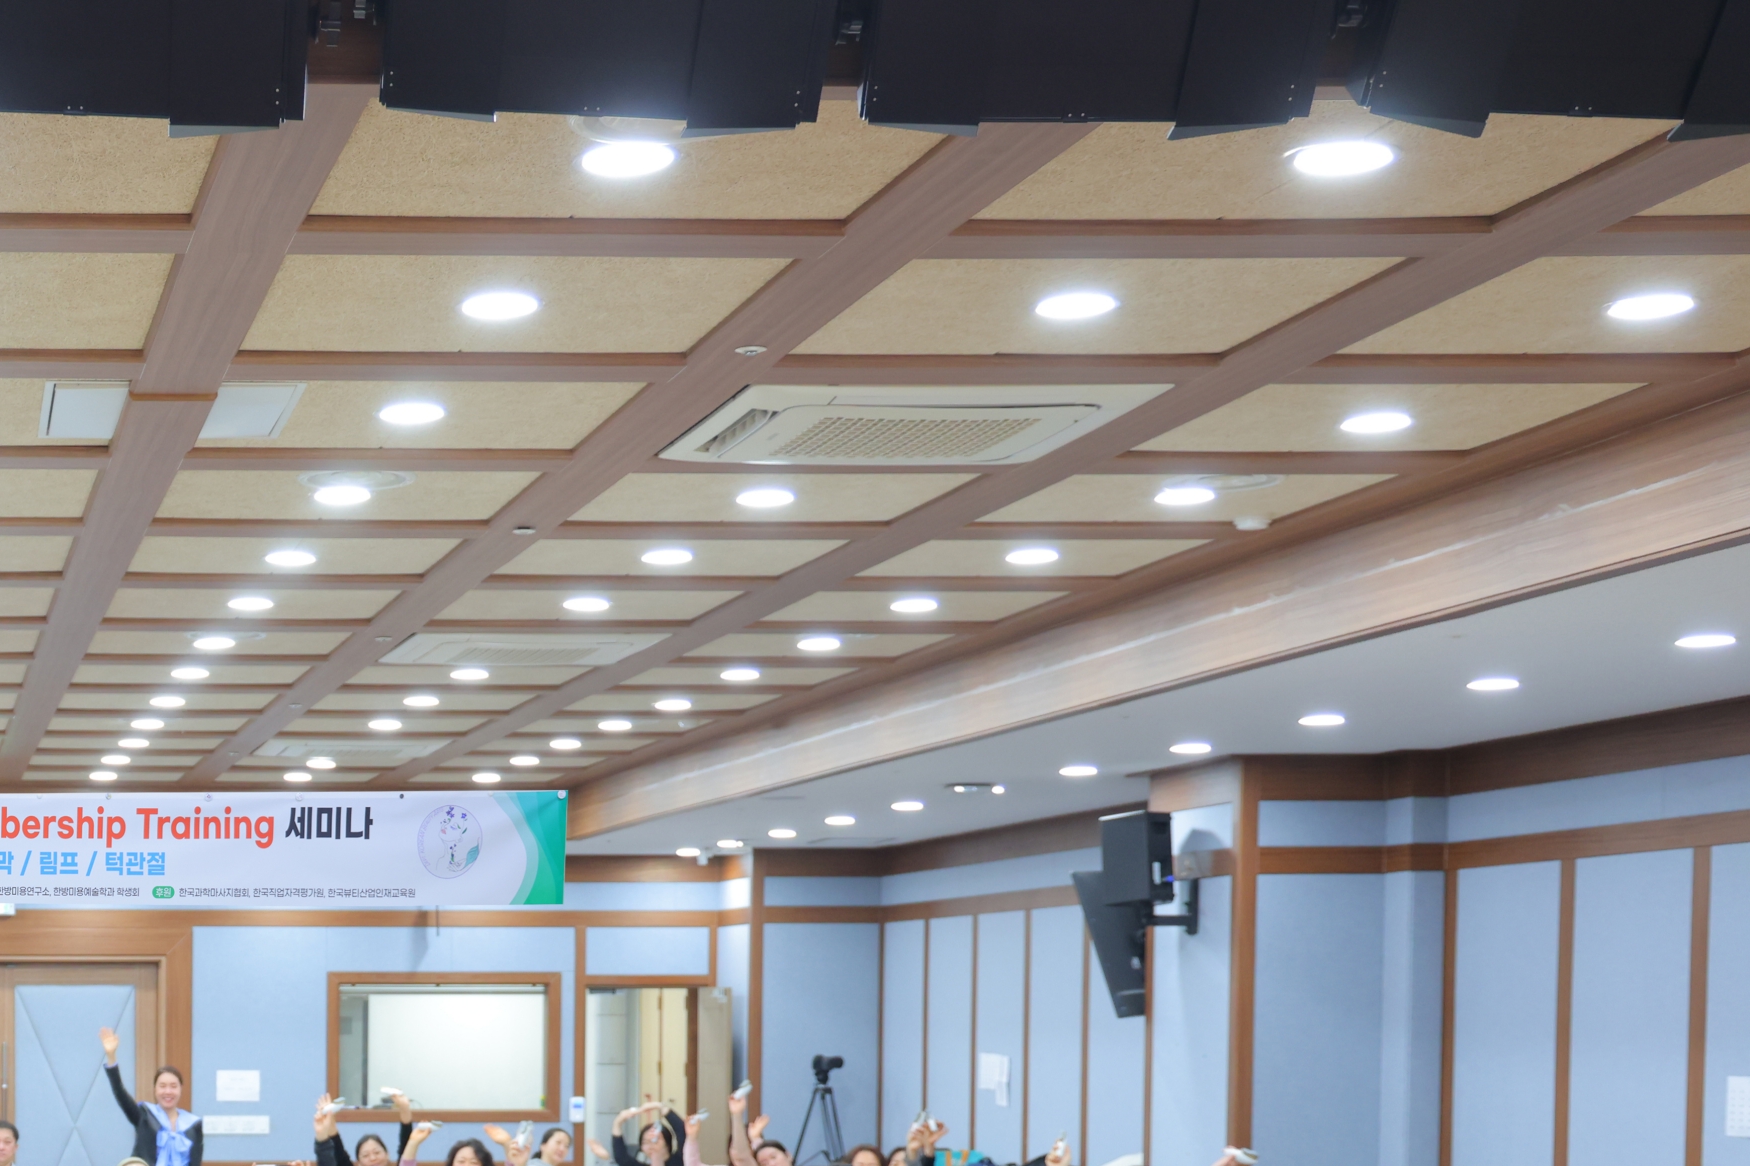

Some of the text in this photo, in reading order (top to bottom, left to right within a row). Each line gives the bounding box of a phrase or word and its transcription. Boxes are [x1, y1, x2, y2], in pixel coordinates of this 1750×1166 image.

[135, 807, 275, 849] Training
[285, 807, 374, 840] 세미나
[20, 850, 32, 876] /
[39, 851, 79, 876] 림프
[86, 851, 97, 876] /
[105, 851, 166, 876] 턱관절
[53, 886, 115, 897] 한방미용예술학과
[117, 887, 140, 897] 학생회
[155, 887, 171, 897] 후원
